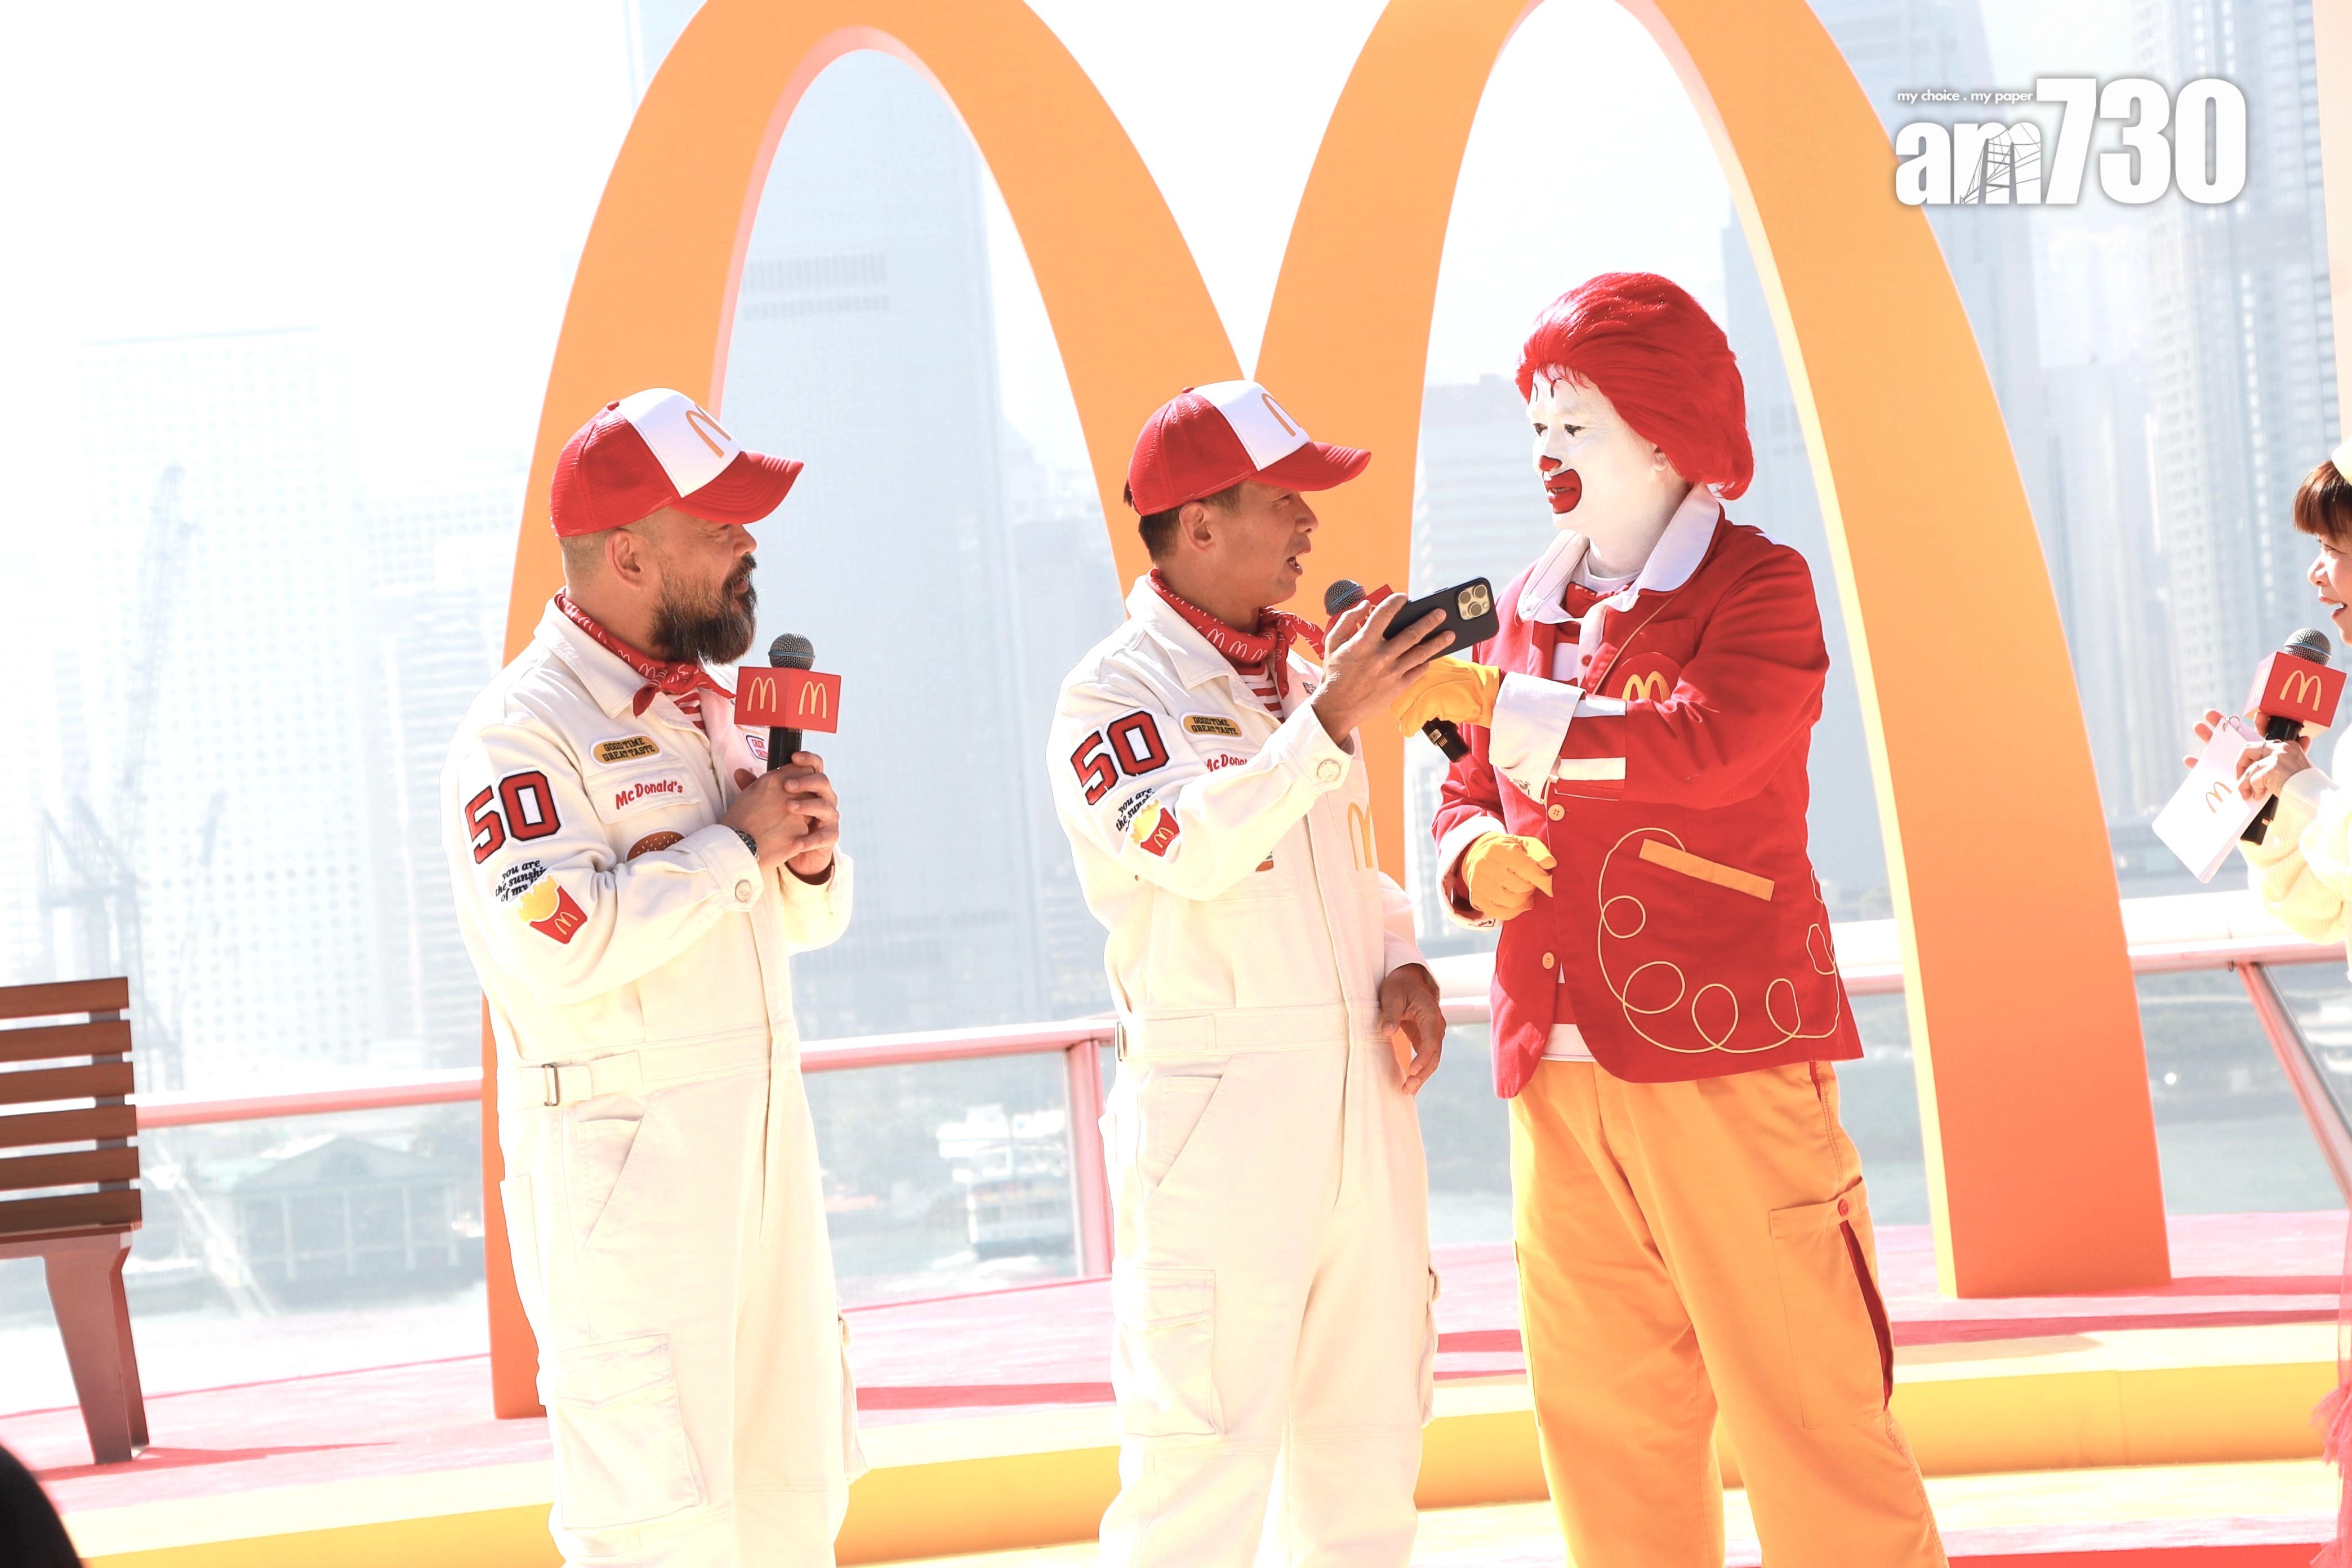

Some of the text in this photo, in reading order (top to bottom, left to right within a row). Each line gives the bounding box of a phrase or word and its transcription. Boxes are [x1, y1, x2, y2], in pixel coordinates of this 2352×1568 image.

[1215, 726, 1239, 735] TASTE
[602, 745, 655, 761] GREAT TASTE
[1070, 710, 1170, 806] 50
[615, 779, 684, 810] McDonald's
[1118, 788, 1152, 817] you are
[465, 770, 562, 865] 50
[1116, 815, 1128, 832] the
[502, 866, 519, 883] you
[522, 859, 541, 871] are
[495, 883, 507, 897] the
